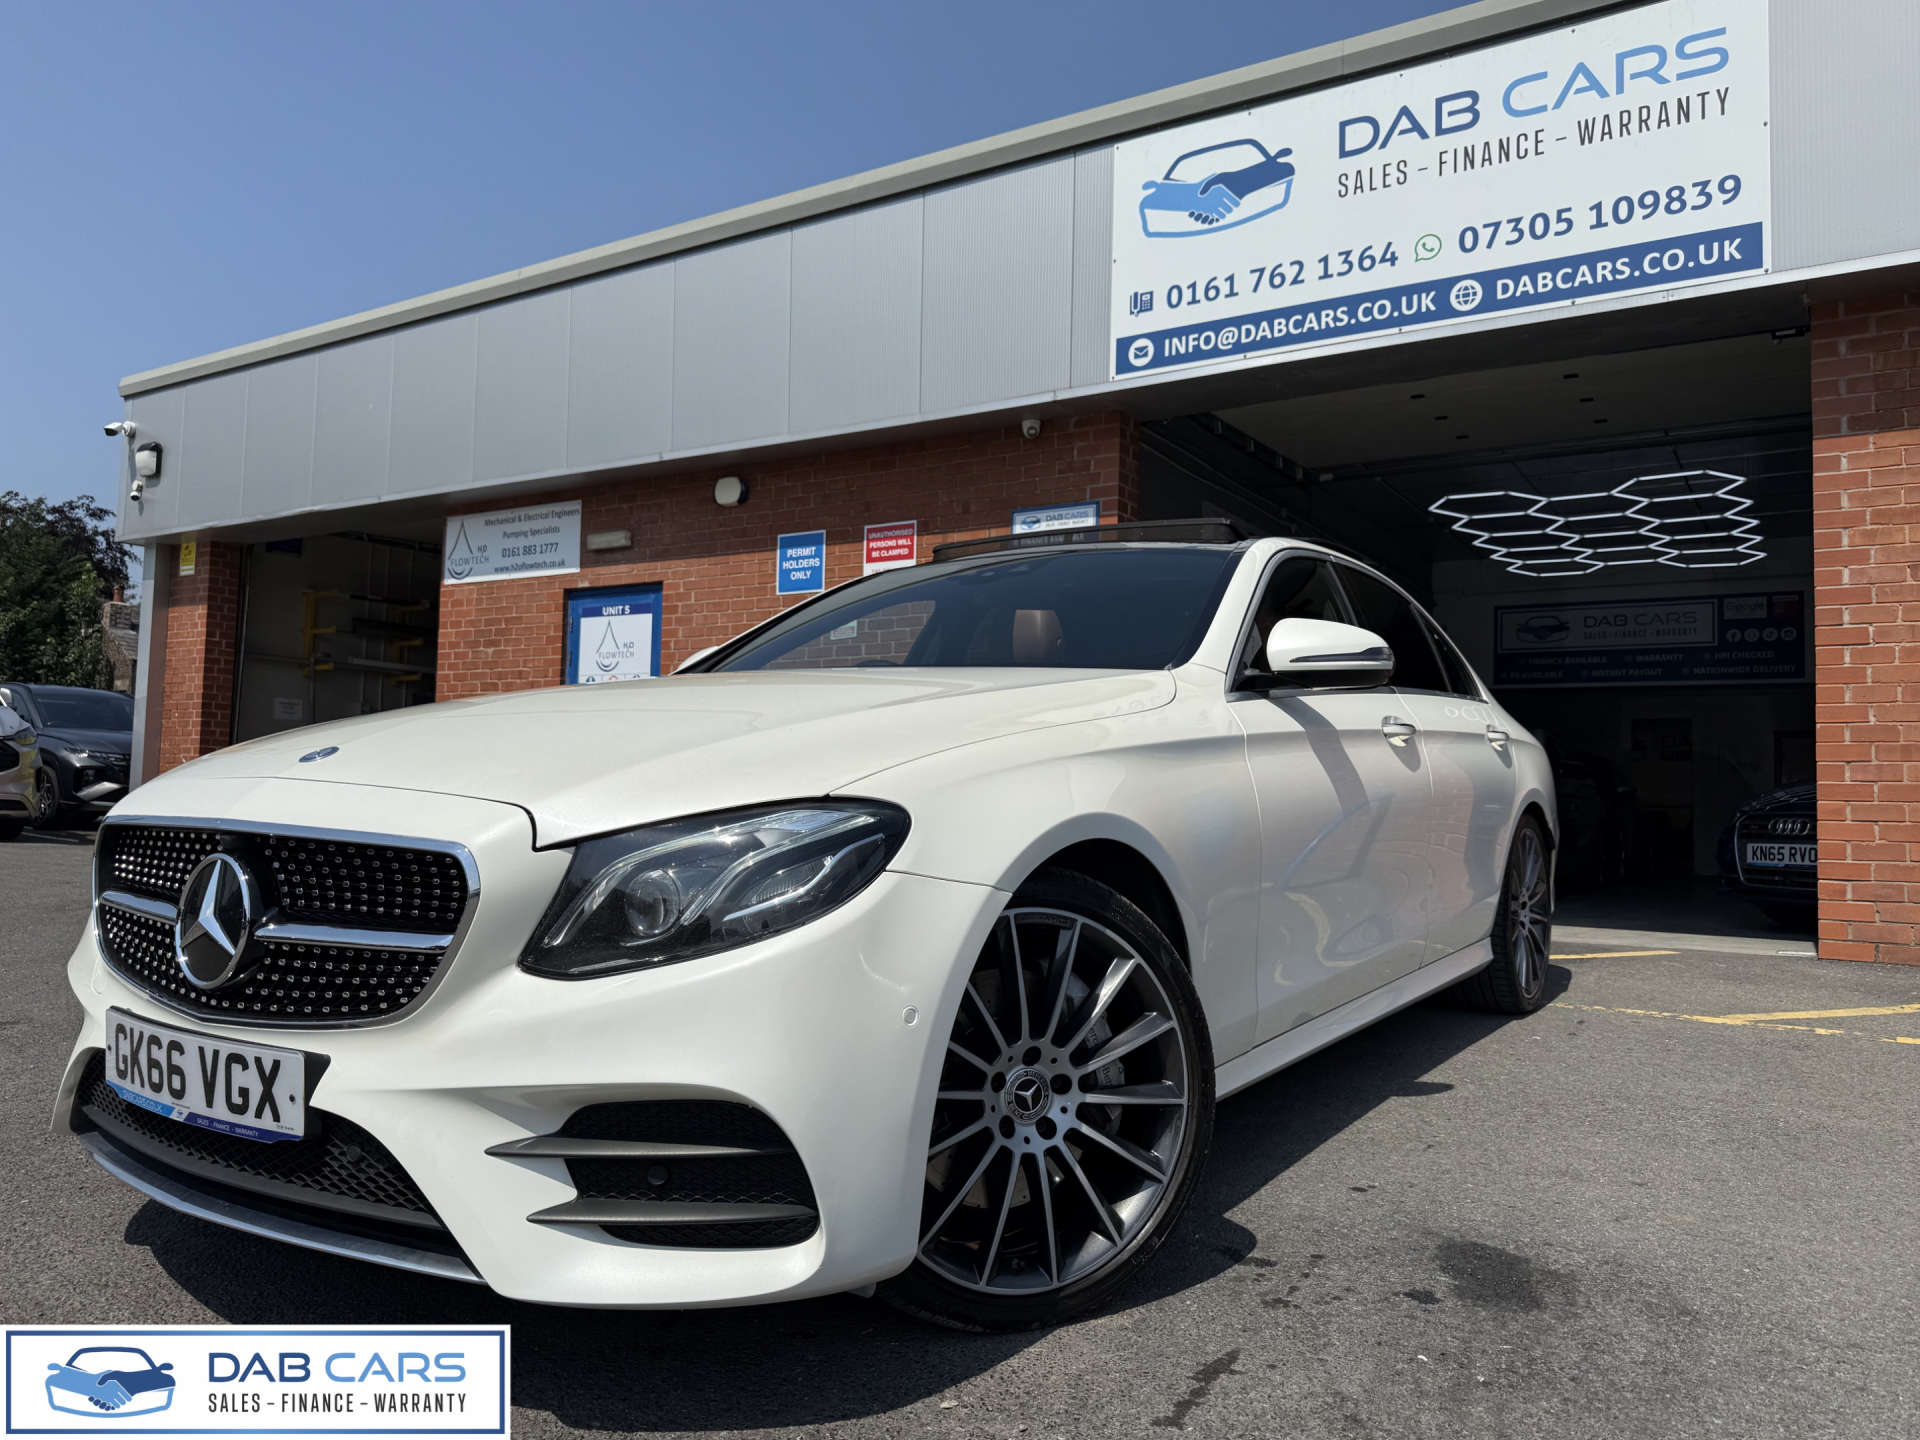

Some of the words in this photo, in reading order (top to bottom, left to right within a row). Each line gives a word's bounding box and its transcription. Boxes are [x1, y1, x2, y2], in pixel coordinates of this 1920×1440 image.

[1338, 89, 1481, 160] DAB
[1502, 26, 1731, 118] CARS
[1337, 158, 1410, 199] SALES
[1438, 128, 1546, 177] FINANCE
[1577, 86, 1731, 146] WARRANTY
[1166, 273, 1238, 310] 0161
[1249, 260, 1305, 294] 762
[1317, 241, 1399, 280] 1364
[1458, 206, 1574, 254] 07305
[1588, 173, 1742, 230] 109839
[1163, 290, 1436, 357] INFO@DABCARS.CO.UK
[1495, 237, 1742, 300] DABCARS.CO.UK
[485, 514, 516, 526] Mechanical
[524, 510, 550, 522] Electrical
[551, 508, 580, 520] Engineers
[502, 530, 528, 540] Pumping
[530, 526, 560, 537] Specialists
[502, 547, 520, 558] 0161
[522, 544, 538, 556] 883
[539, 542, 559, 554] 1777
[870, 540, 896, 548] PERSONS
[897, 538, 912, 546] WILL
[787, 547, 816, 558] PERMIT
[872, 550, 880, 558] BE
[880, 548, 910, 557] CLAMPED
[450, 555, 489, 567] FLOWTECH
[782, 557, 820, 570] HOLDERS
[790, 569, 812, 580] ONLY
[602, 606, 624, 616] UNIT
[624, 605, 630, 614] 5
[1584, 614, 1628, 628] DAB
[1634, 611, 1698, 626] CARS
[1752, 845, 1784, 862] KN65
[115, 1022, 186, 1100] GK66
[198, 1046, 280, 1122] VGX
